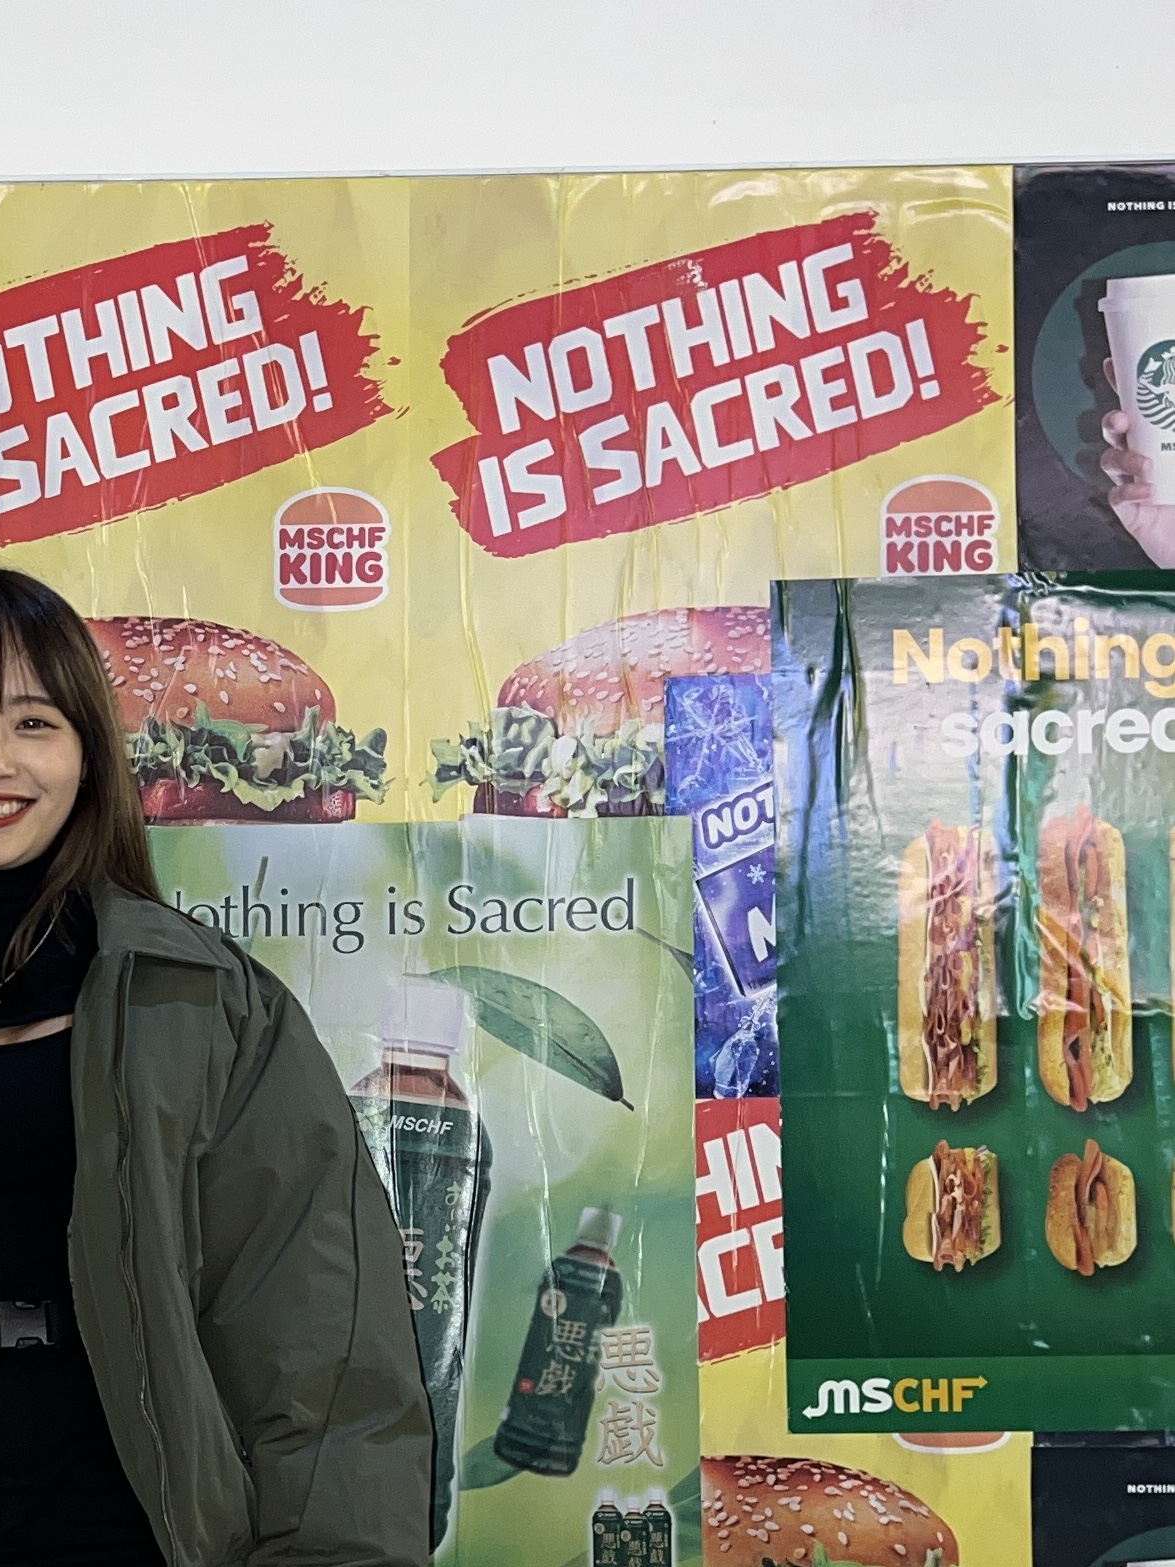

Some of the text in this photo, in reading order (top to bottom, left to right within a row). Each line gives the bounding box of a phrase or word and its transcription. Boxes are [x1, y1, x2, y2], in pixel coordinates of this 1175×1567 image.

[1107, 201, 1165, 211] NOTHING
[487, 243, 869, 435] NOTHING
[478, 318, 941, 537] IS SACRED!
[279, 527, 386, 550] MSCHF
[885, 514, 995, 538] MSCHF
[279, 551, 384, 585] KING
[885, 539, 993, 574] KING
[892, 617, 1175, 698] Nothing
[175, 878, 635, 953] othing is Sacred
[389, 1115, 453, 1135] MSCHF
[802, 1376, 988, 1419] MSCHF
